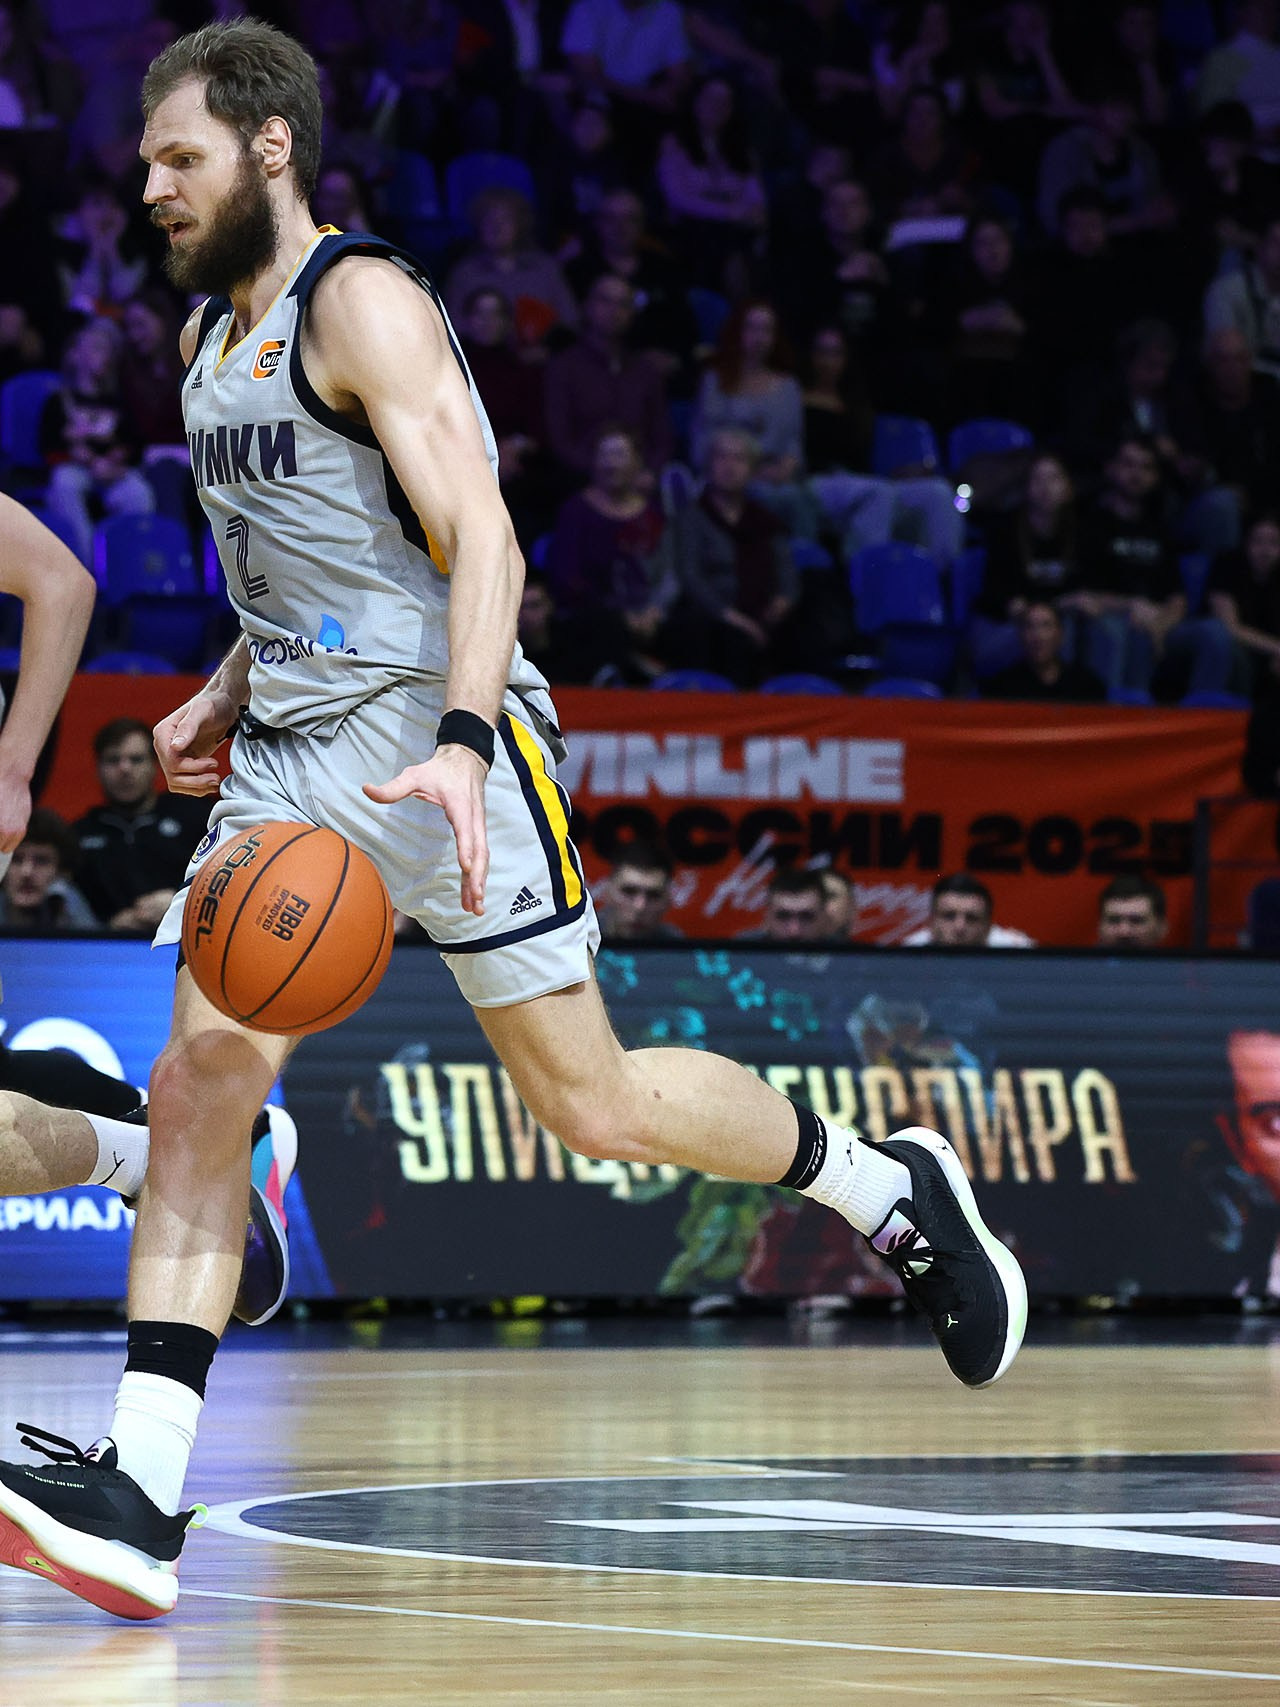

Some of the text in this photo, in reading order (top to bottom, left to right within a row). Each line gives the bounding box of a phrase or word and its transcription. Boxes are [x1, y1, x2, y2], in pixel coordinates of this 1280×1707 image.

[188, 421, 298, 489] ИМКИ
[225, 514, 270, 601] 2
[572, 805, 942, 869] ОССИИ
[271, 893, 312, 942] FIBA
[509, 898, 543, 916] adidas
[380, 1063, 680, 1199] УЛИ
[704, 1064, 1138, 1184] КСПИРА
